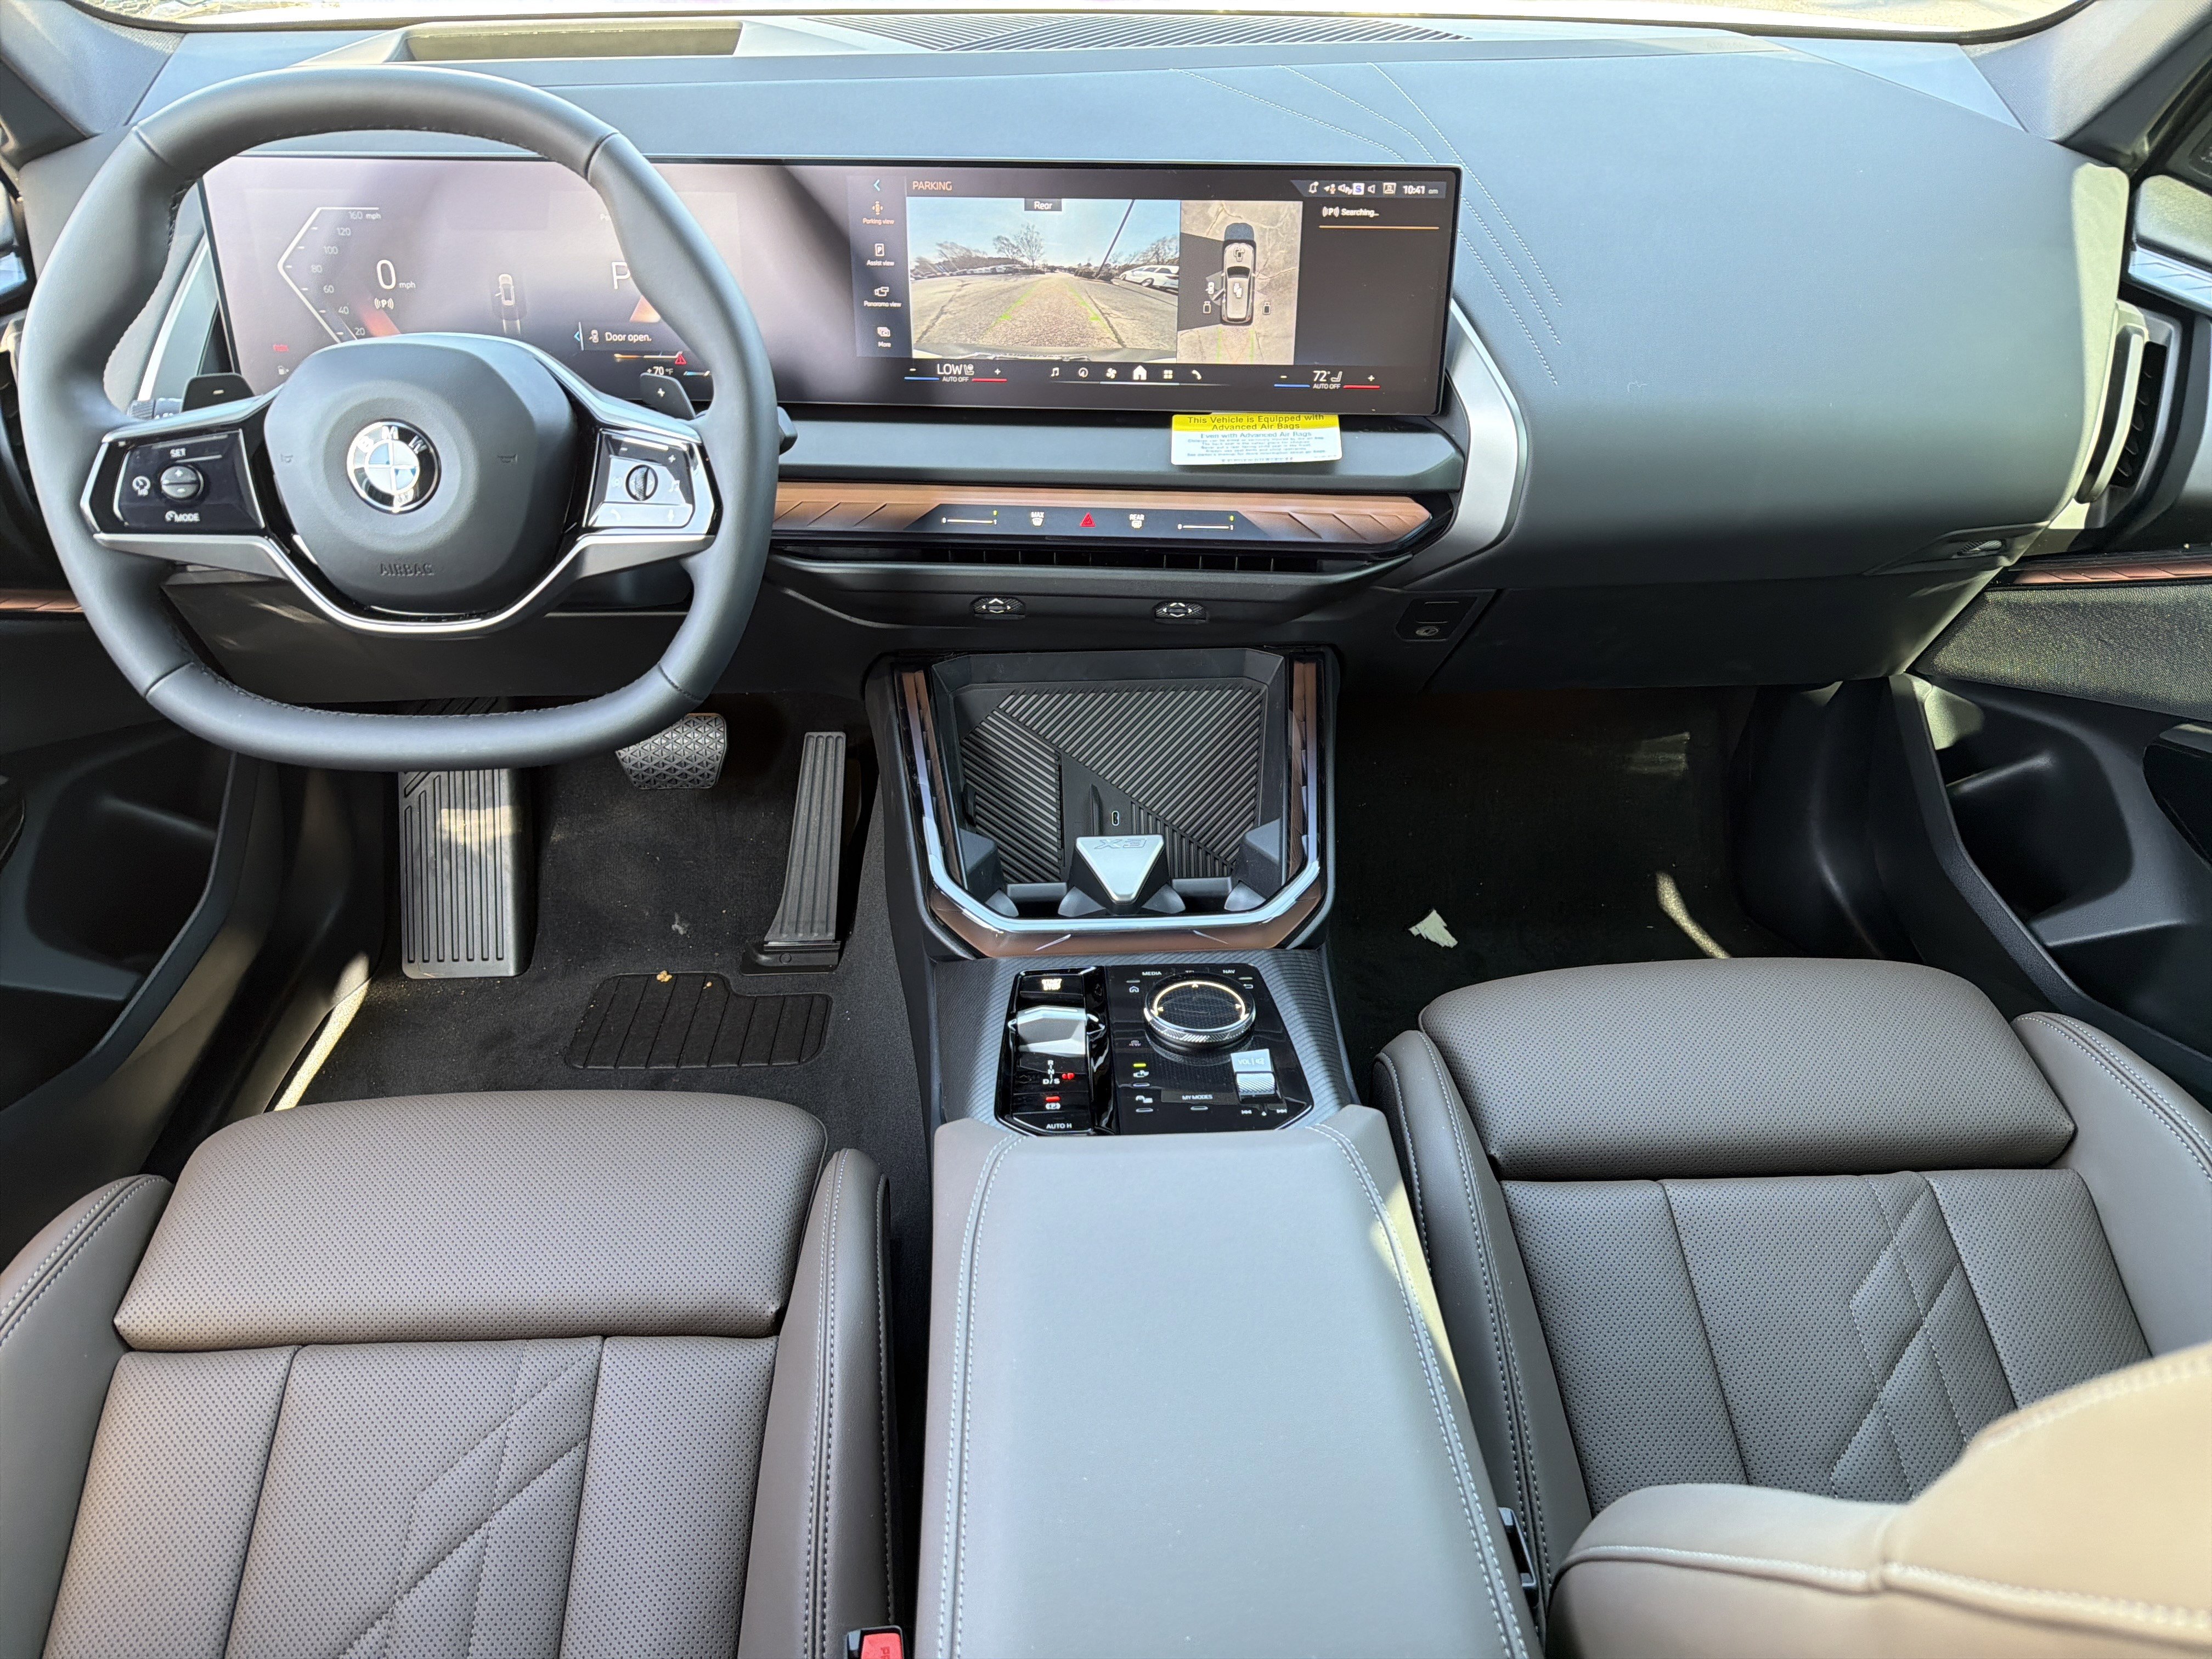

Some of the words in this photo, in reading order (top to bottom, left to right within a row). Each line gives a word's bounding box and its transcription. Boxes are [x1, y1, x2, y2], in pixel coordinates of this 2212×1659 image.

[912, 180, 952, 190] PARKING
[1403, 185, 1426, 195] 10:41
[1034, 201, 1053, 210] Rear
[348, 211, 363, 219] 160
[336, 227, 351, 236] 120
[323, 246, 338, 255] 100
[311, 264, 323, 273] 80
[376, 259, 396, 290] 0
[612, 262, 631, 290] P
[323, 285, 335, 293] 60
[399, 281, 416, 289] mph
[338, 306, 349, 314] 40
[354, 328, 365, 336] 20
[605, 331, 627, 341] Door
[628, 333, 652, 343] open.
[937, 363, 962, 375] LOW
[1258, 415, 1301, 424] Equipped
[356, 425, 427, 454] BMW
[170, 448, 186, 458] SET
[174, 512, 200, 522] MODE
[380, 563, 435, 577] AIRBAG
[1094, 838, 1147, 850] X3
